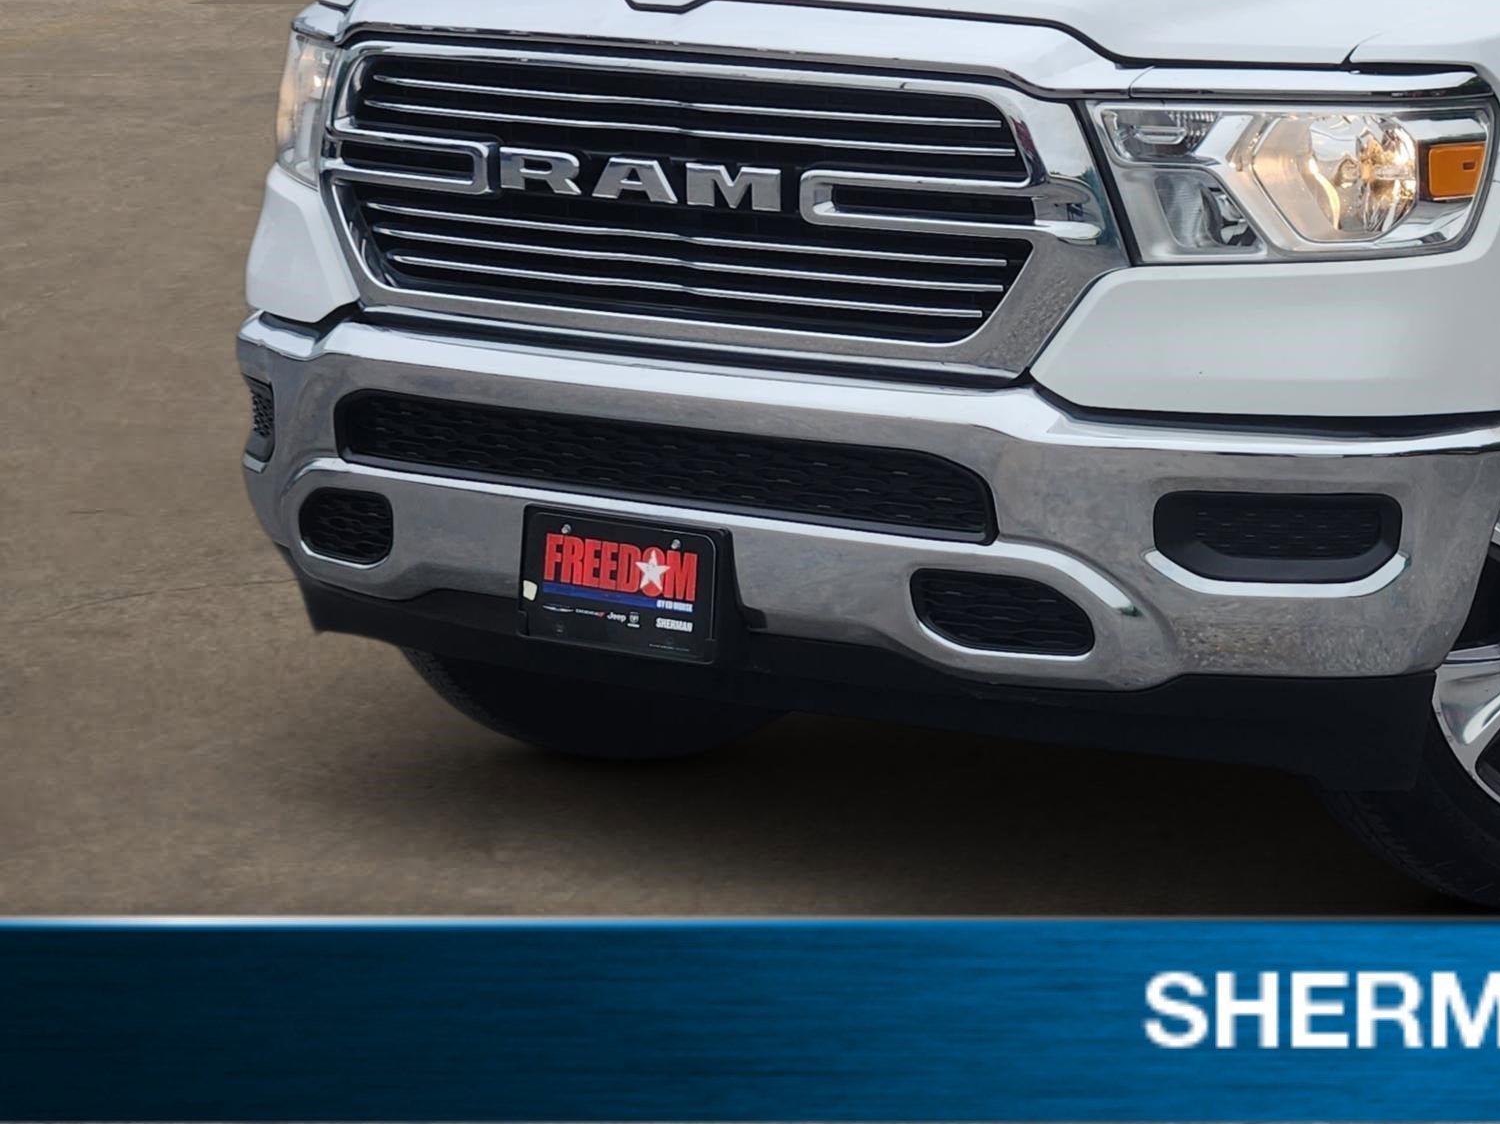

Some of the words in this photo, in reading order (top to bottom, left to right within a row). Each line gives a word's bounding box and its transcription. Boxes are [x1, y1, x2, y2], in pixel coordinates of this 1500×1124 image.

[499, 145, 782, 213] RAM
[543, 532, 698, 602] FREEDOM
[606, 611, 627, 623] Jeep
